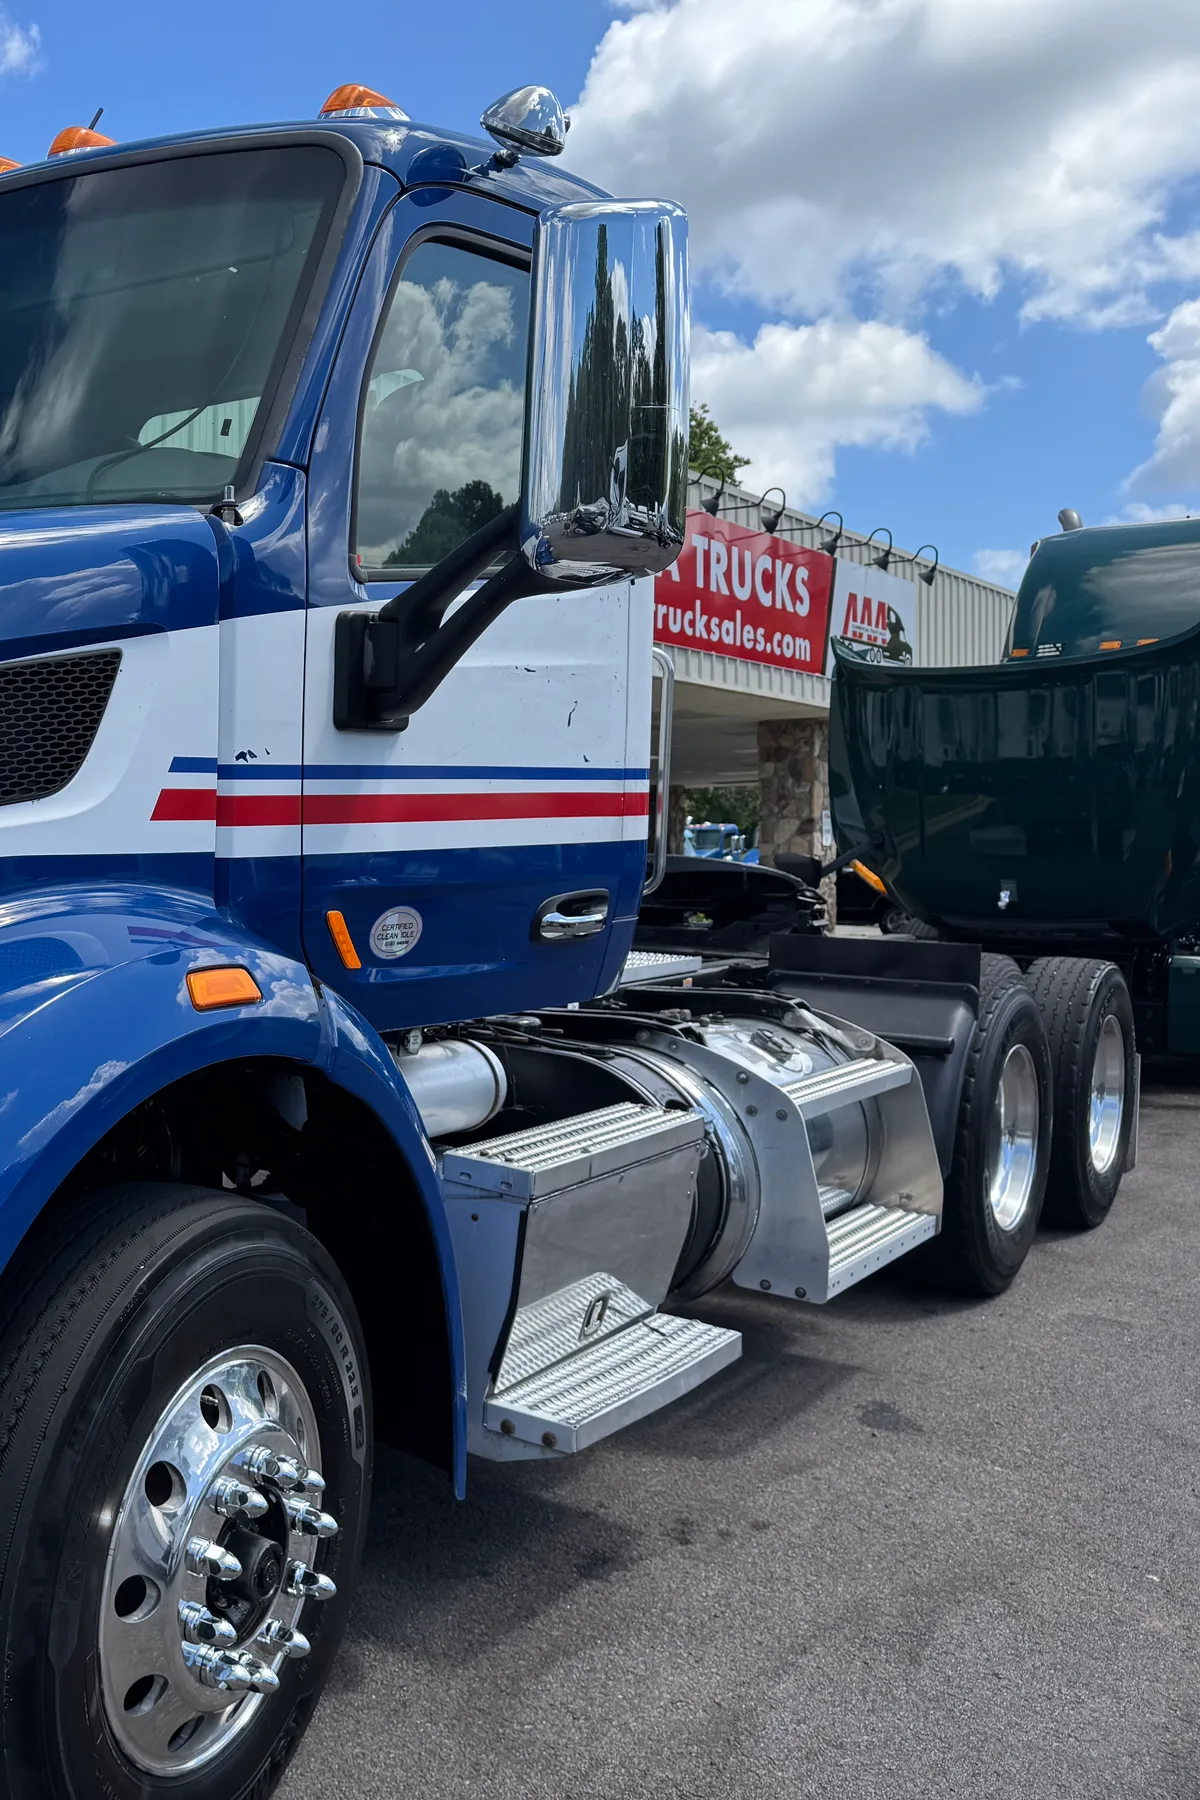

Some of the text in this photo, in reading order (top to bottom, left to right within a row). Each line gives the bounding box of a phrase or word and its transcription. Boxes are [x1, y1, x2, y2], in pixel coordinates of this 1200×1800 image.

[691, 533, 810, 617] TRUCKS
[654, 600, 811, 662] rucksales.com
[842, 592, 886, 644] AAA
[377, 932, 399, 940] CLEAN
[381, 922, 414, 931] CERTIFIED
